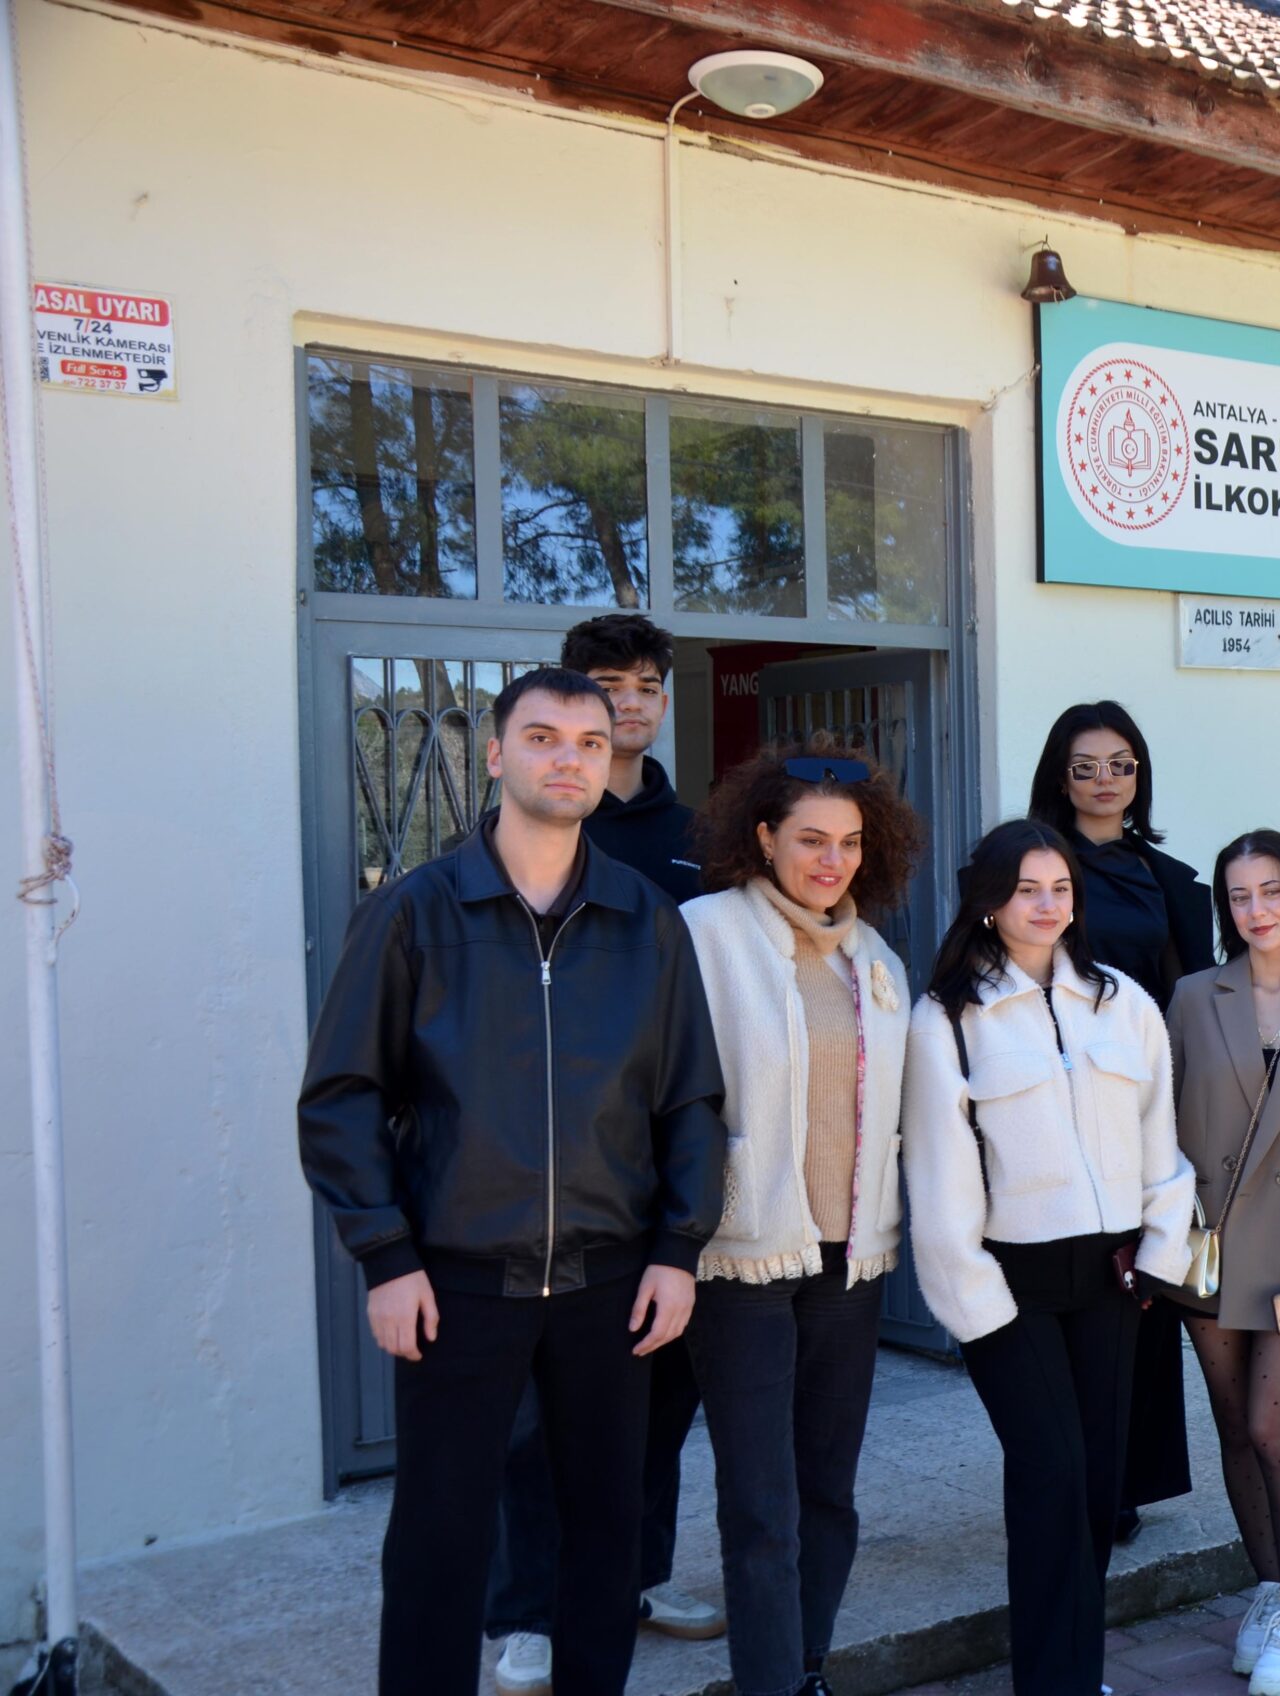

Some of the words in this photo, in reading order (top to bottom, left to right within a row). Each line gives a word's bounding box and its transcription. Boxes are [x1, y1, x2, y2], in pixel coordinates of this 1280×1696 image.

[35, 289, 92, 314] ASAL
[97, 296, 160, 322] UYARI
[74, 318, 112, 334] 7/24
[37, 329, 91, 345] VENLİK
[95, 337, 171, 353] KAMERASI
[49, 342, 166, 365] İZLENMEKTEDİR
[66, 363, 86, 374] Full
[89, 365, 122, 378] Servis
[78, 378, 96, 388] 722
[100, 380, 111, 389] 37
[115, 382, 127, 390] 37
[1091, 389, 1124, 453] CUMHURİYETİ
[1193, 401, 1267, 425] ANTALYA
[1239, 608, 1275, 628] TARİHİ
[1223, 637, 1250, 652] 1954
[720, 672, 759, 696] YANG
